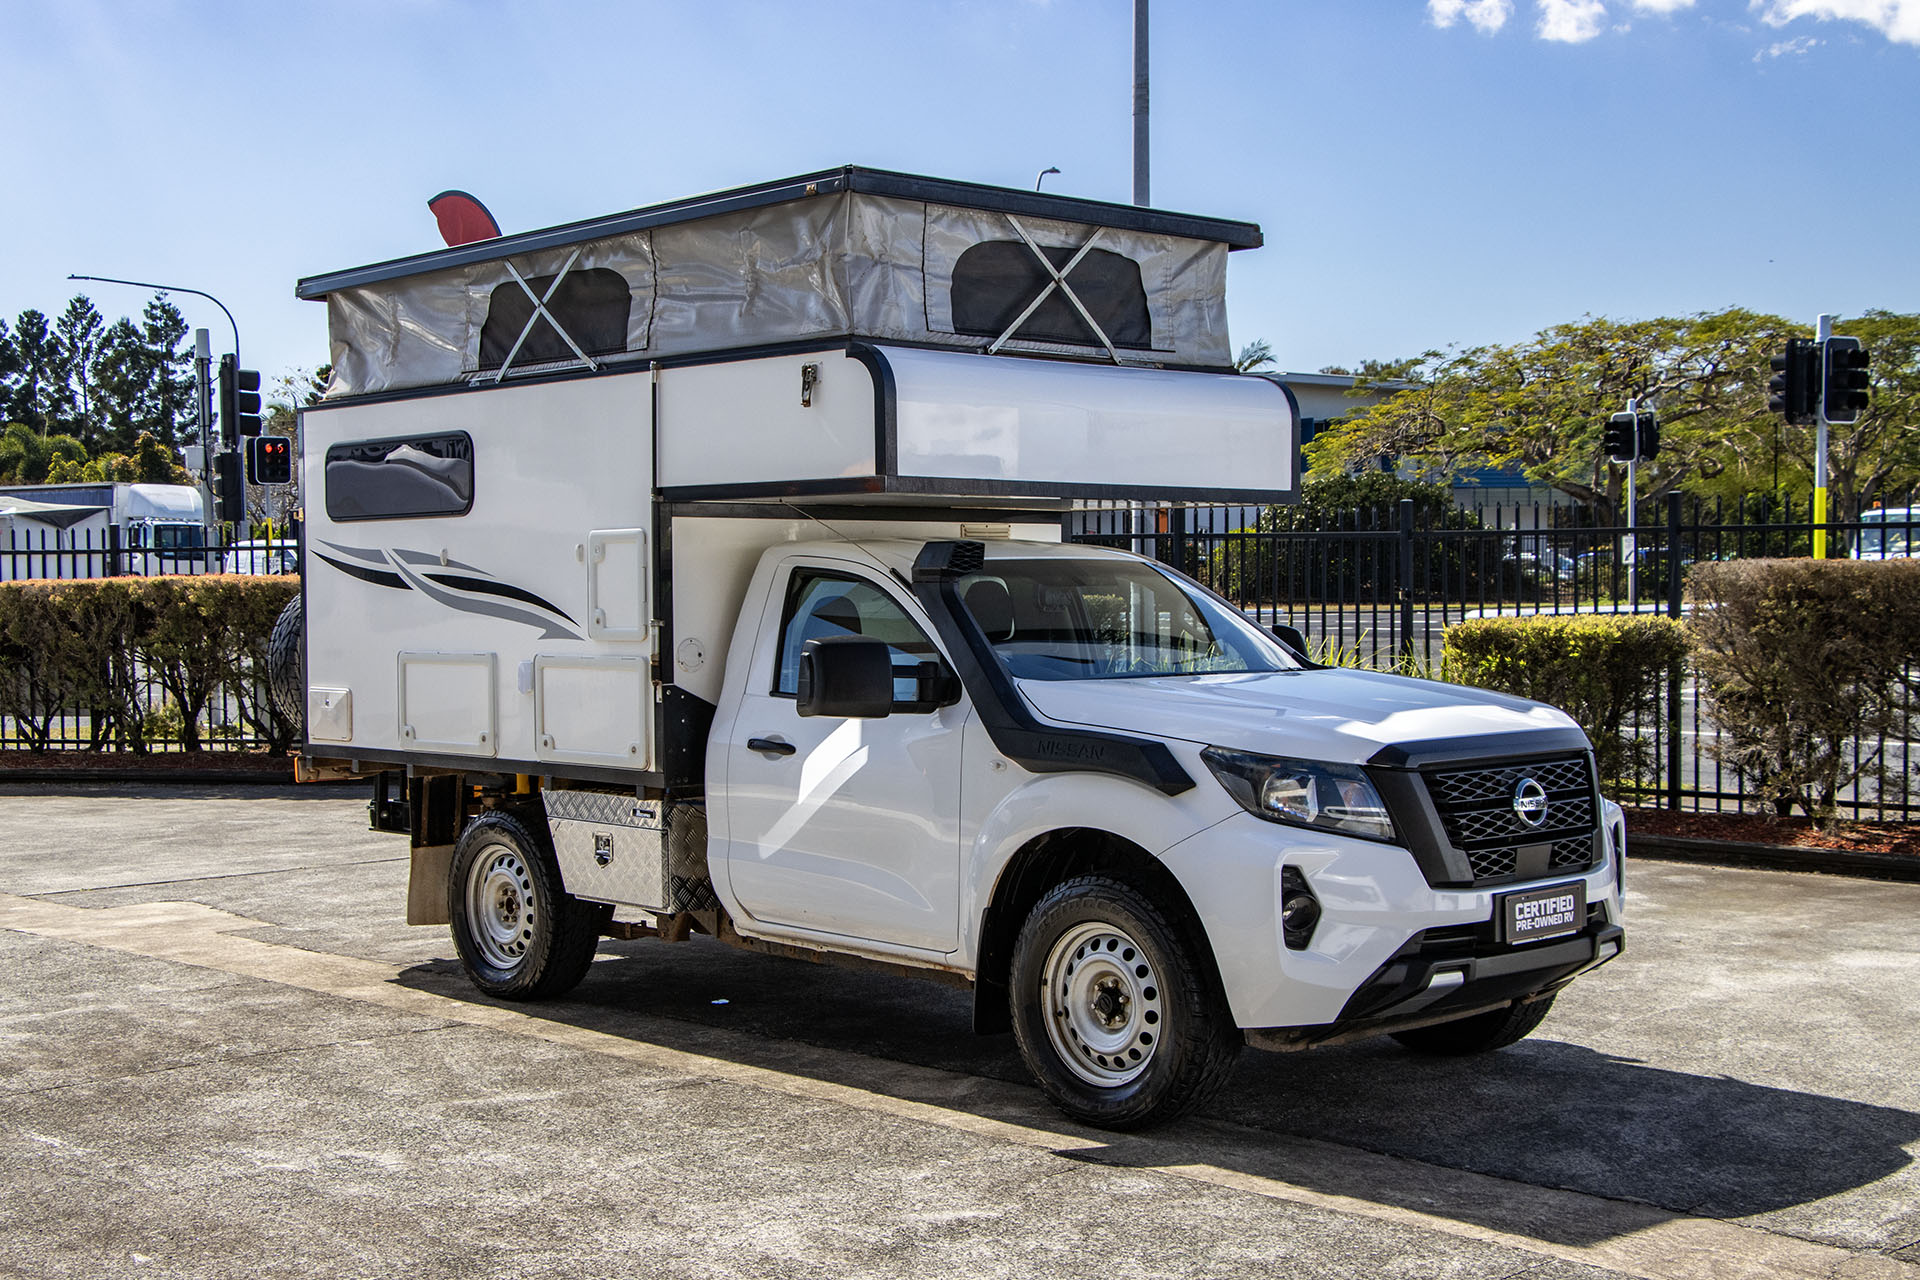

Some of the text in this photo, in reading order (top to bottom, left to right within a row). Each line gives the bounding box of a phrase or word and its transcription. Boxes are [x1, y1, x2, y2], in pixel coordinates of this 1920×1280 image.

[1037, 740, 1105, 760] NISSAN
[1515, 894, 1575, 920] CERTIFIED
[1515, 911, 1575, 932] PRE-OWNED RV
